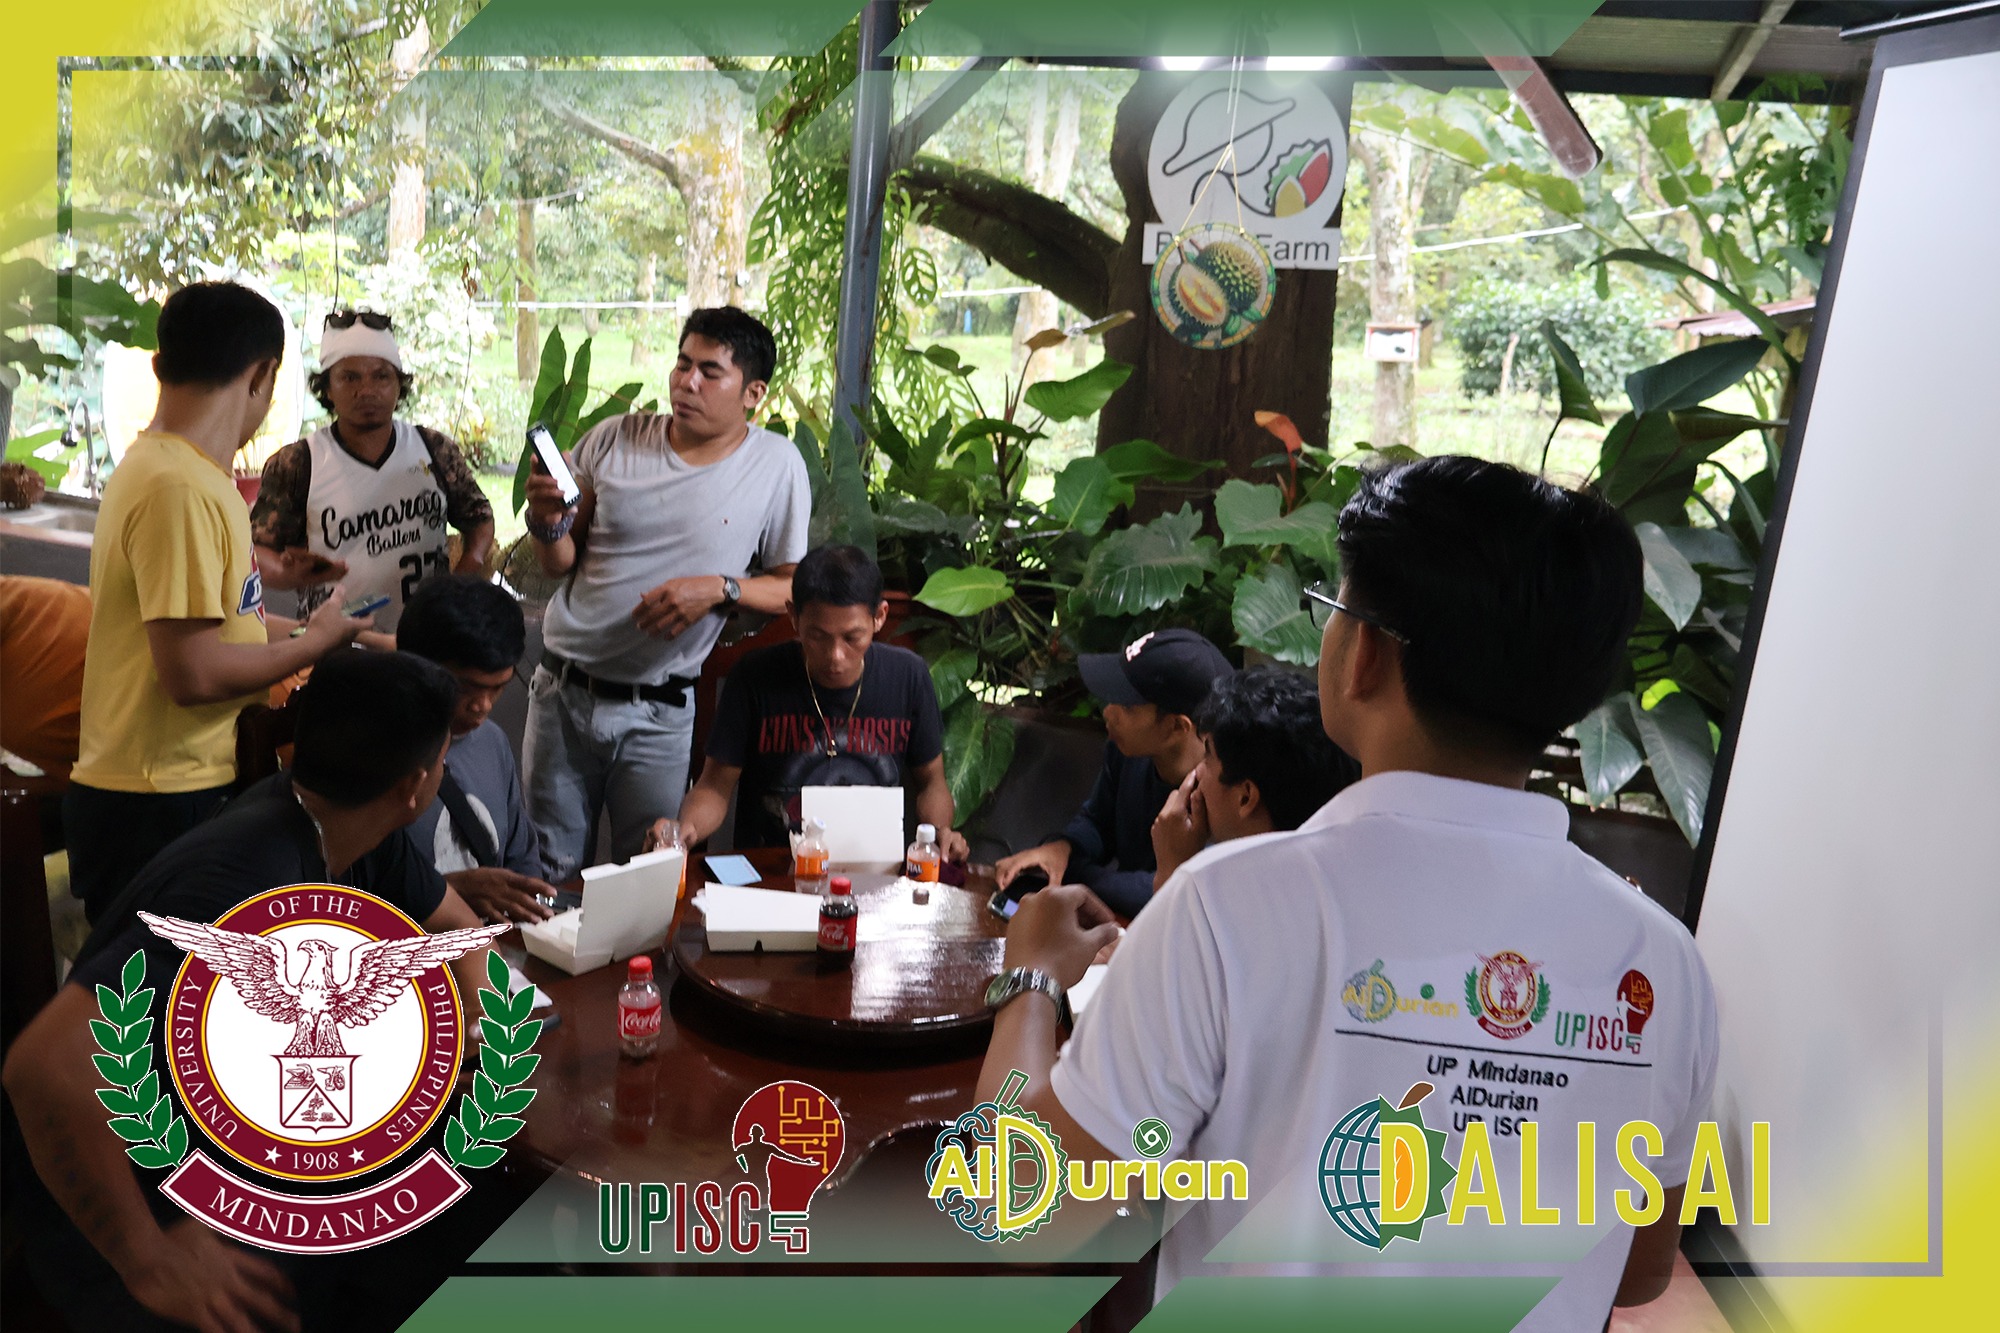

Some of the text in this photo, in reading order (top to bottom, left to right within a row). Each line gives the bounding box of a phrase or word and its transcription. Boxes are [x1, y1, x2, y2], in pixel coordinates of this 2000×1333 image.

[367, 527, 421, 557] Ballers
[759, 713, 815, 752] GUNS
[847, 716, 912, 755] ROSES
[1555, 1010, 1624, 1051] UPISC
[1427, 1054, 1569, 1088] UP Mindanao
